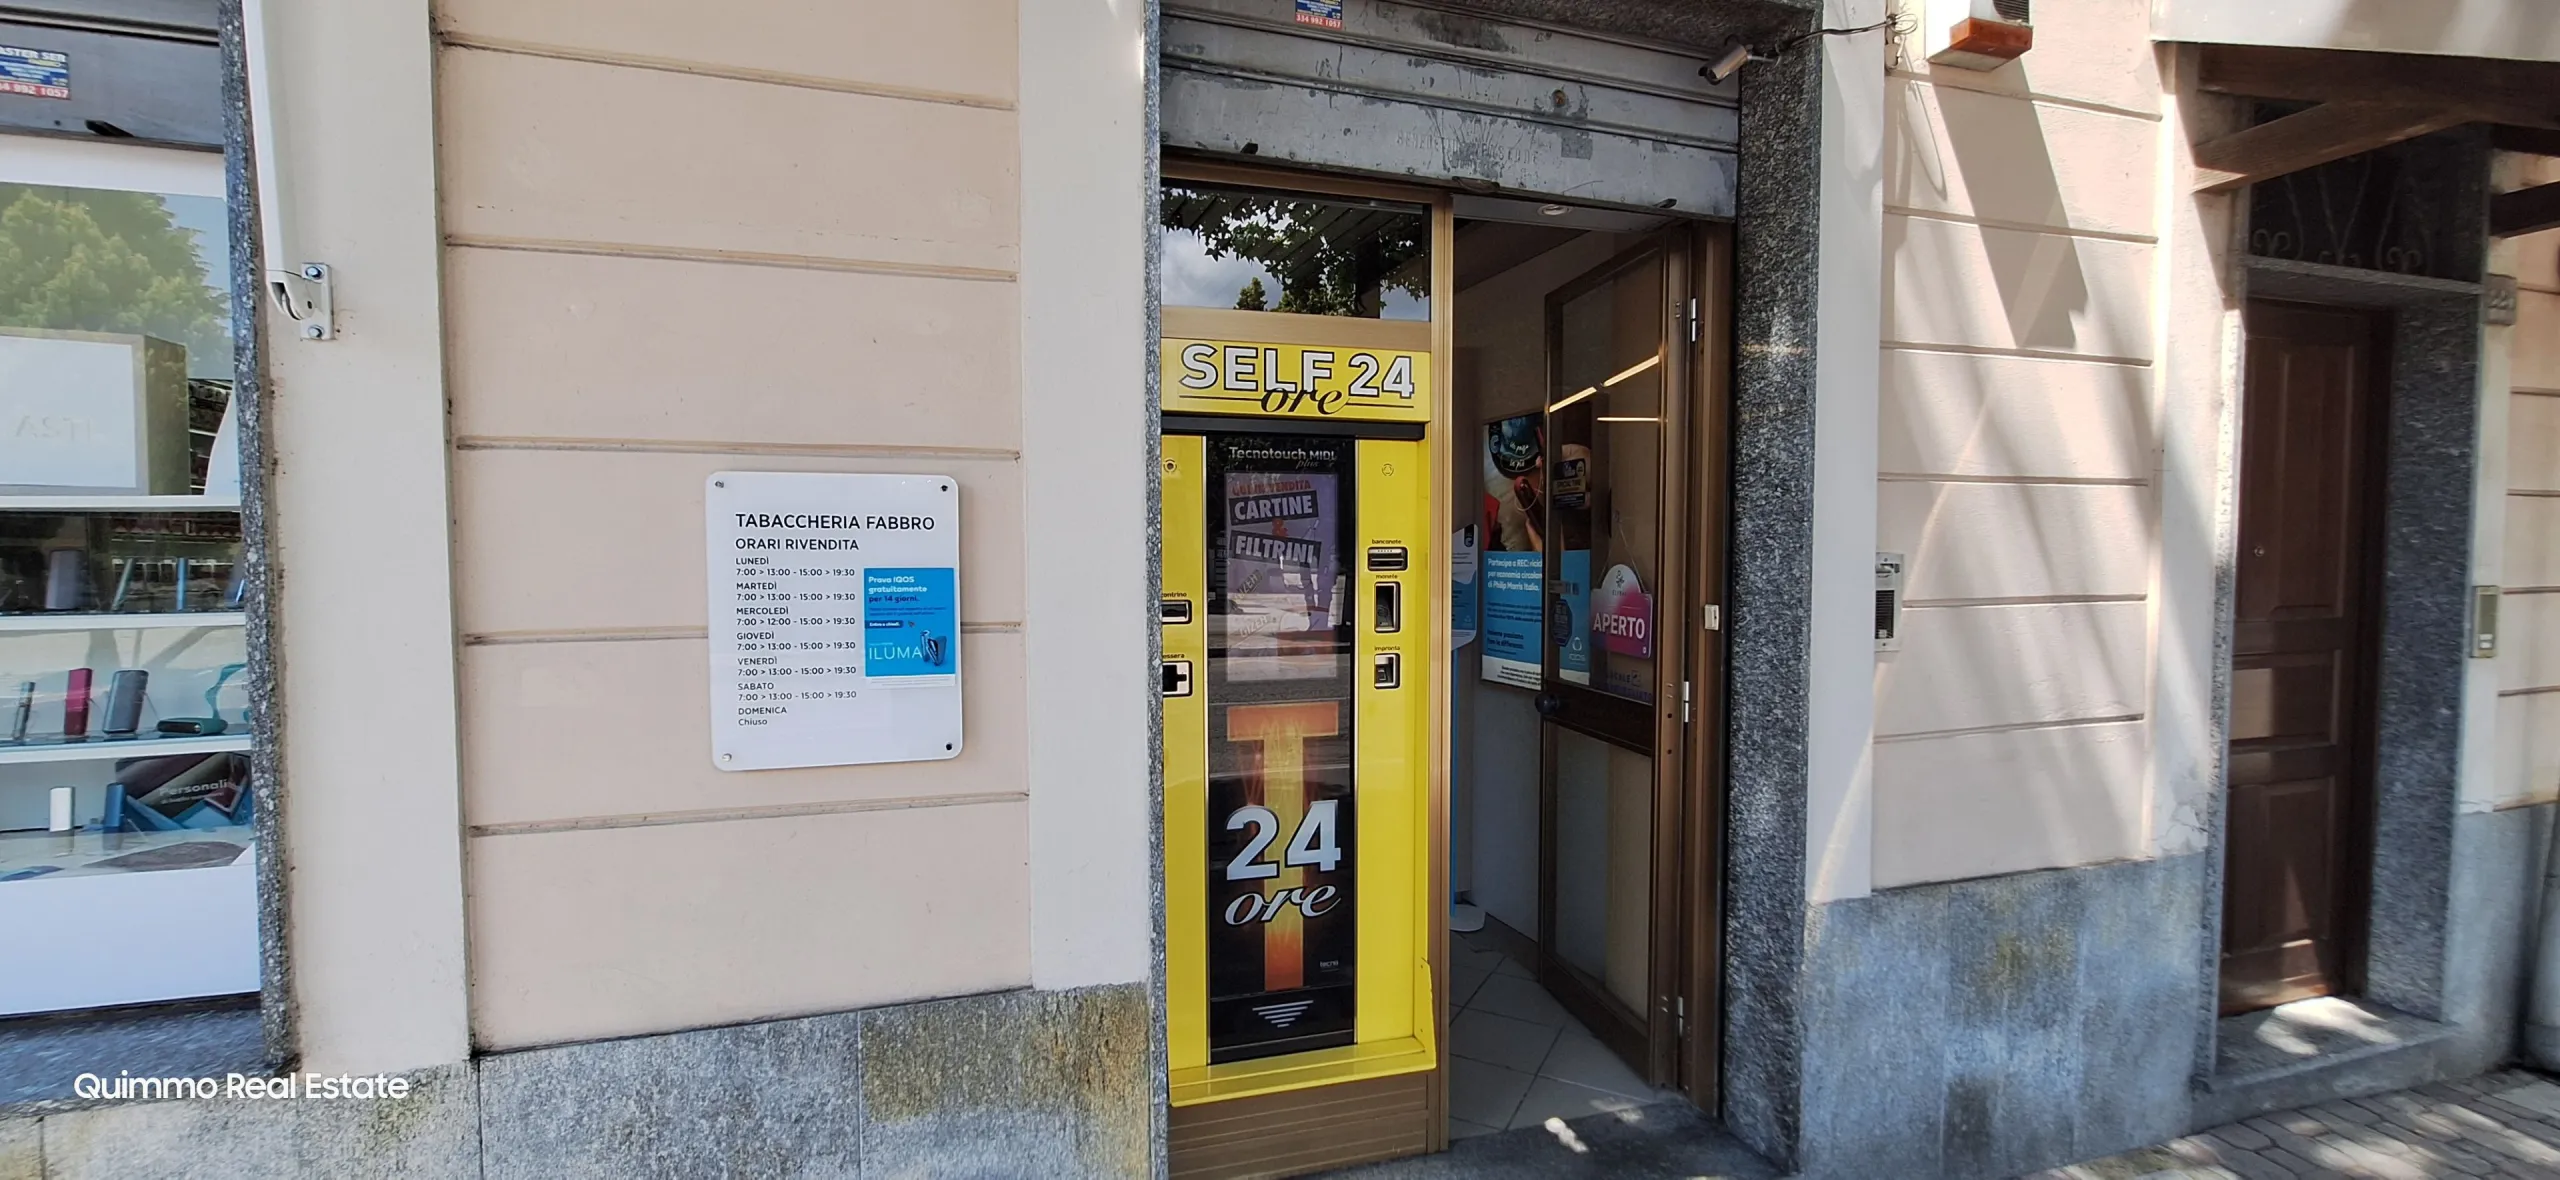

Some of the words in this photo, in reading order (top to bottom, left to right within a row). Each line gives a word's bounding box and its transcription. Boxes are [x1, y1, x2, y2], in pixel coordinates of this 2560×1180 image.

[1310, 16, 1323, 25] 992
[1325, 19, 1342, 28] 1057
[13, 83, 36, 95] 992
[41, 86, 69, 98] 1057
[1179, 343, 1335, 394] SELF
[1348, 352, 1415, 399] 24
[1260, 386, 1350, 415] ore
[1228, 446, 1307, 460] Tecnotouch
[1267, 480, 1311, 493] VENDITA
[1234, 495, 1313, 520] CARTINE
[735, 513, 861, 530] TABACCHERIA
[866, 516, 935, 530] FABBRO
[1272, 518, 1288, 537] &
[735, 538, 781, 550] ORARI
[785, 538, 859, 550] RIVENDITA
[1235, 535, 1315, 564] FILTRINI
[735, 556, 769, 565] LUNEDÌ
[736, 581, 777, 590] MARTEDÌ
[893, 576, 915, 584] IQOS
[1507, 581, 1523, 590] Morris
[868, 585, 928, 595] gratuitamente
[868, 596, 882, 604] per
[884, 595, 893, 603] 14
[736, 606, 789, 615] MERCOLEDÌ
[1593, 612, 1645, 639] APERTO
[736, 631, 775, 640] GIOVEDÌ
[869, 646, 923, 660] ILUMA
[738, 656, 778, 665] VENERDÌ
[738, 682, 775, 690] SABATO
[738, 706, 788, 715] DOMENICA
[738, 718, 768, 726] Chiuso
[1226, 799, 1341, 881] 24
[1224, 884, 1342, 926] ore
